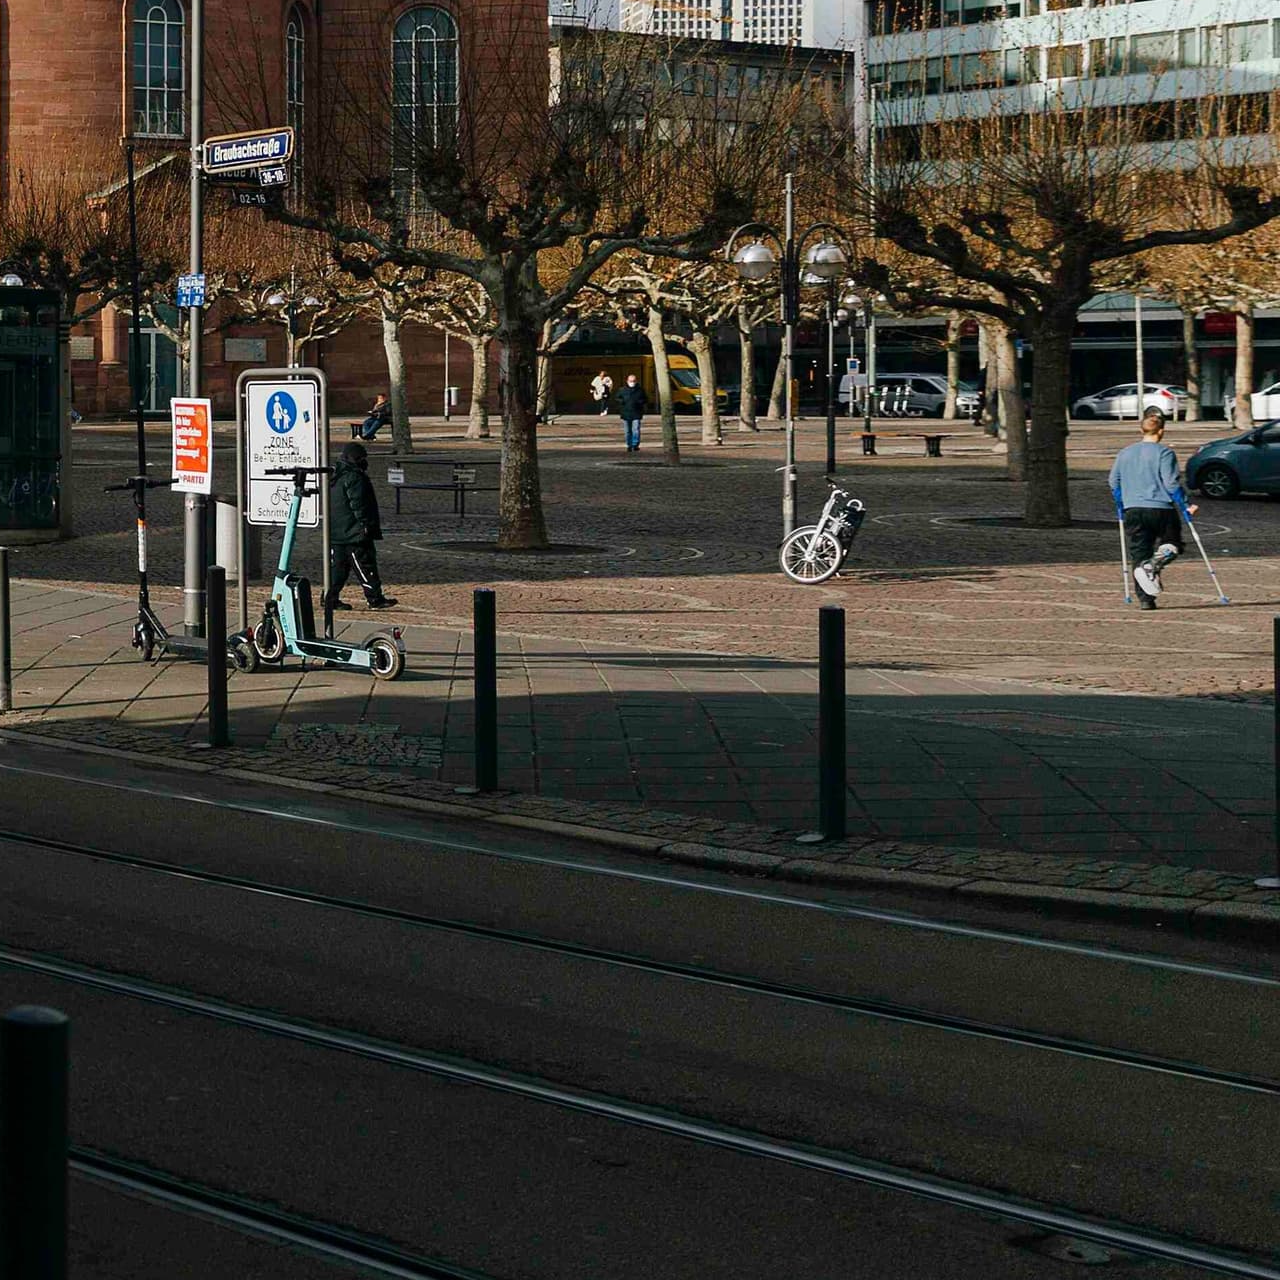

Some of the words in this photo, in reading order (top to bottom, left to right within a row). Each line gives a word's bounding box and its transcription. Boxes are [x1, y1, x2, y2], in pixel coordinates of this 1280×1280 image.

[214, 137, 280, 163] Braubachstraße
[270, 436, 294, 448] ZONE
[254, 453, 267, 463] Be-
[279, 454, 311, 463] Entladen
[183, 474, 205, 484] PARTEI
[280, 606, 289, 633] TIER
